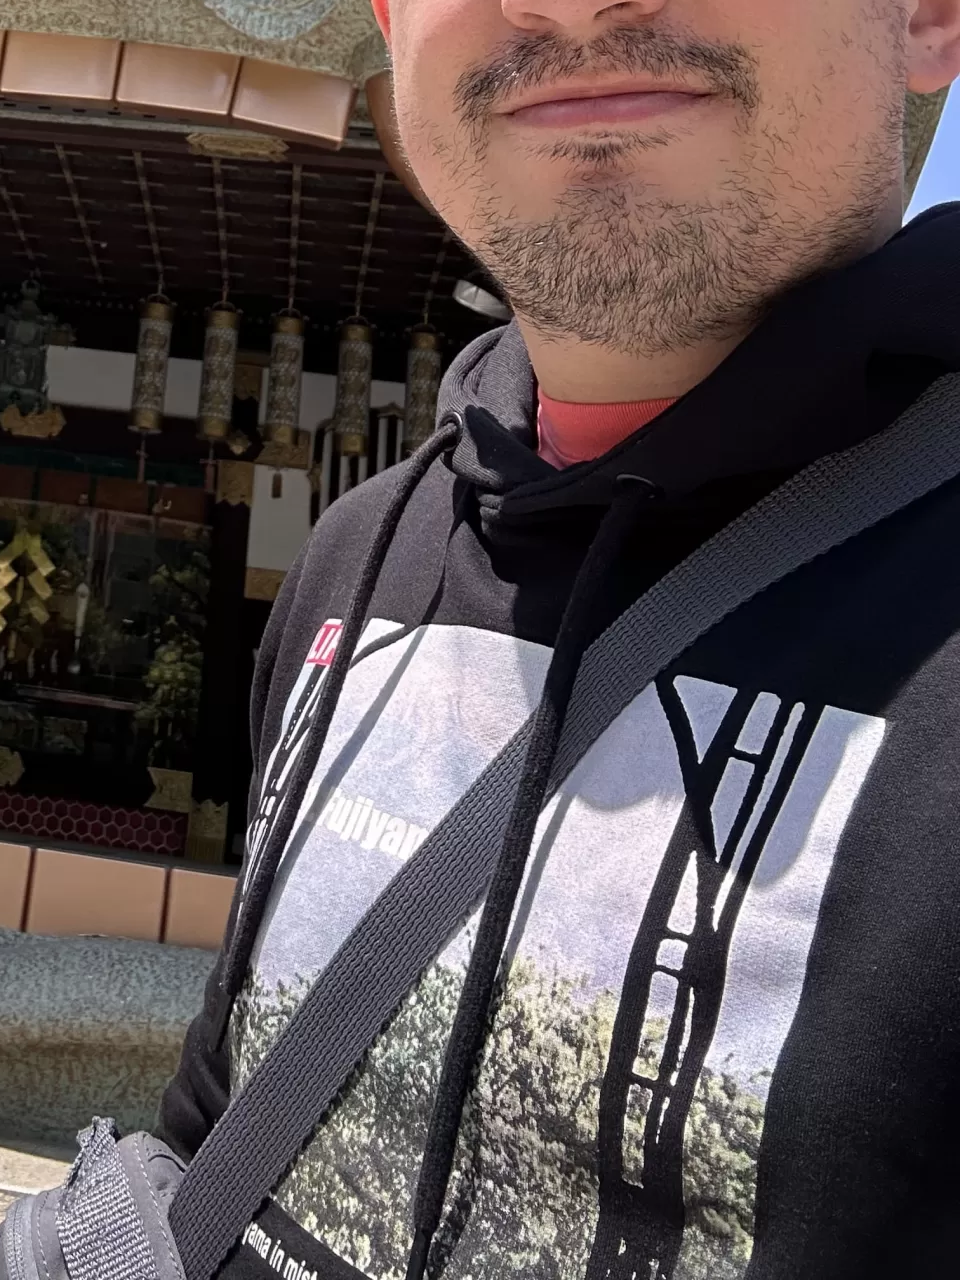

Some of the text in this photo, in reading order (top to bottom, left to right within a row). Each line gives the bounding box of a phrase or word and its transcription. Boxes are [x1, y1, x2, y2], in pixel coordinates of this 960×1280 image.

[315, 785, 430, 862] Fujiyam
[242, 1221, 271, 1260] yama
[269, 1239, 285, 1273] in
